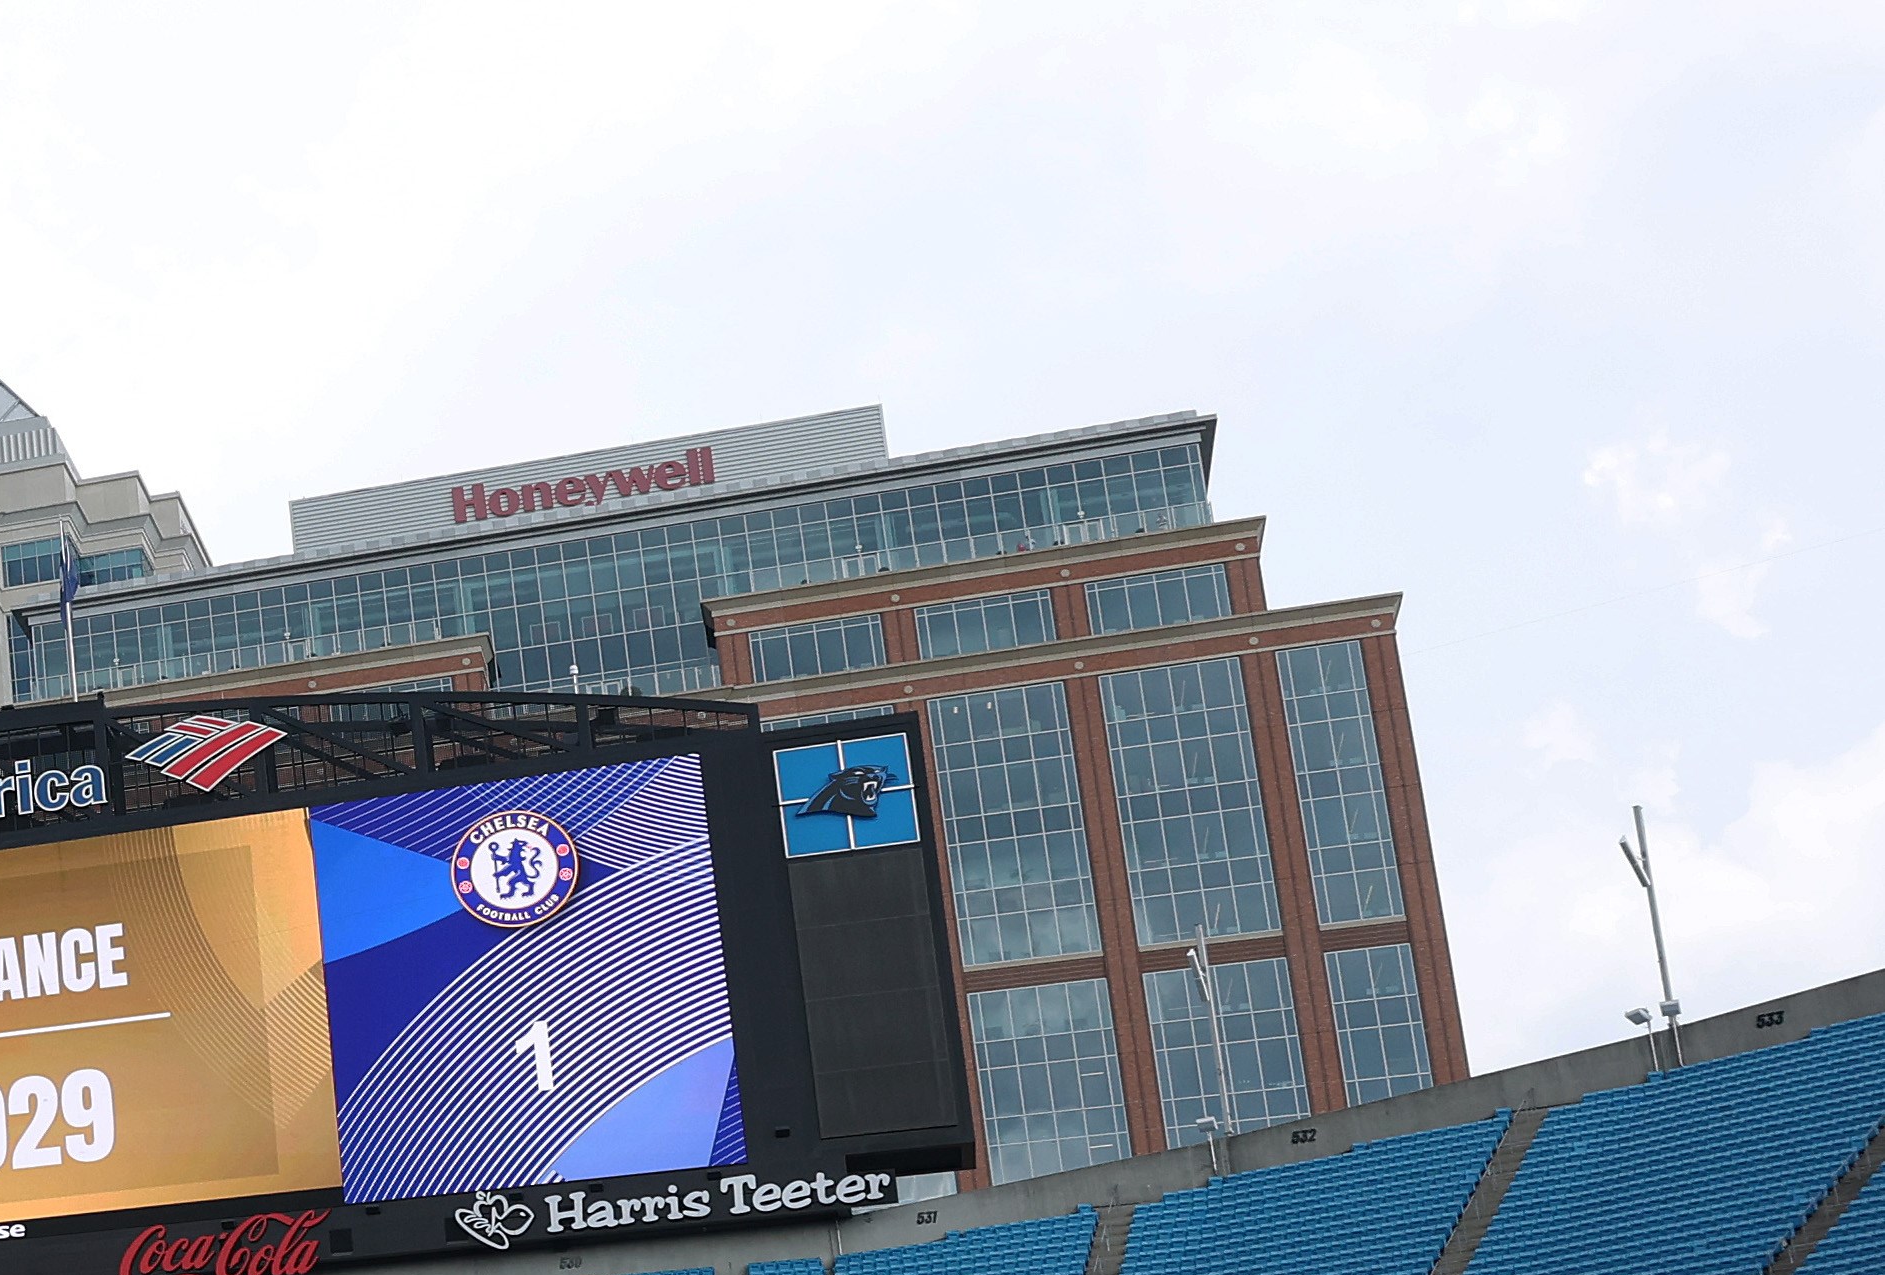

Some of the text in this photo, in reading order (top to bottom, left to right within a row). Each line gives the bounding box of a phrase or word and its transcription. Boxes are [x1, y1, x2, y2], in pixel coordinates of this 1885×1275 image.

[451, 446, 715, 523] Honeywell
[469, 814, 550, 844] CHELSEA
[476, 893, 560, 922] FOOTBALL CLUB
[1756, 1011, 1785, 1029] 533
[516, 1020, 555, 1092] 1
[1292, 1128, 1317, 1144] 532
[546, 1168, 892, 1233] Harris Teeter
[916, 1211, 938, 1226] 531
